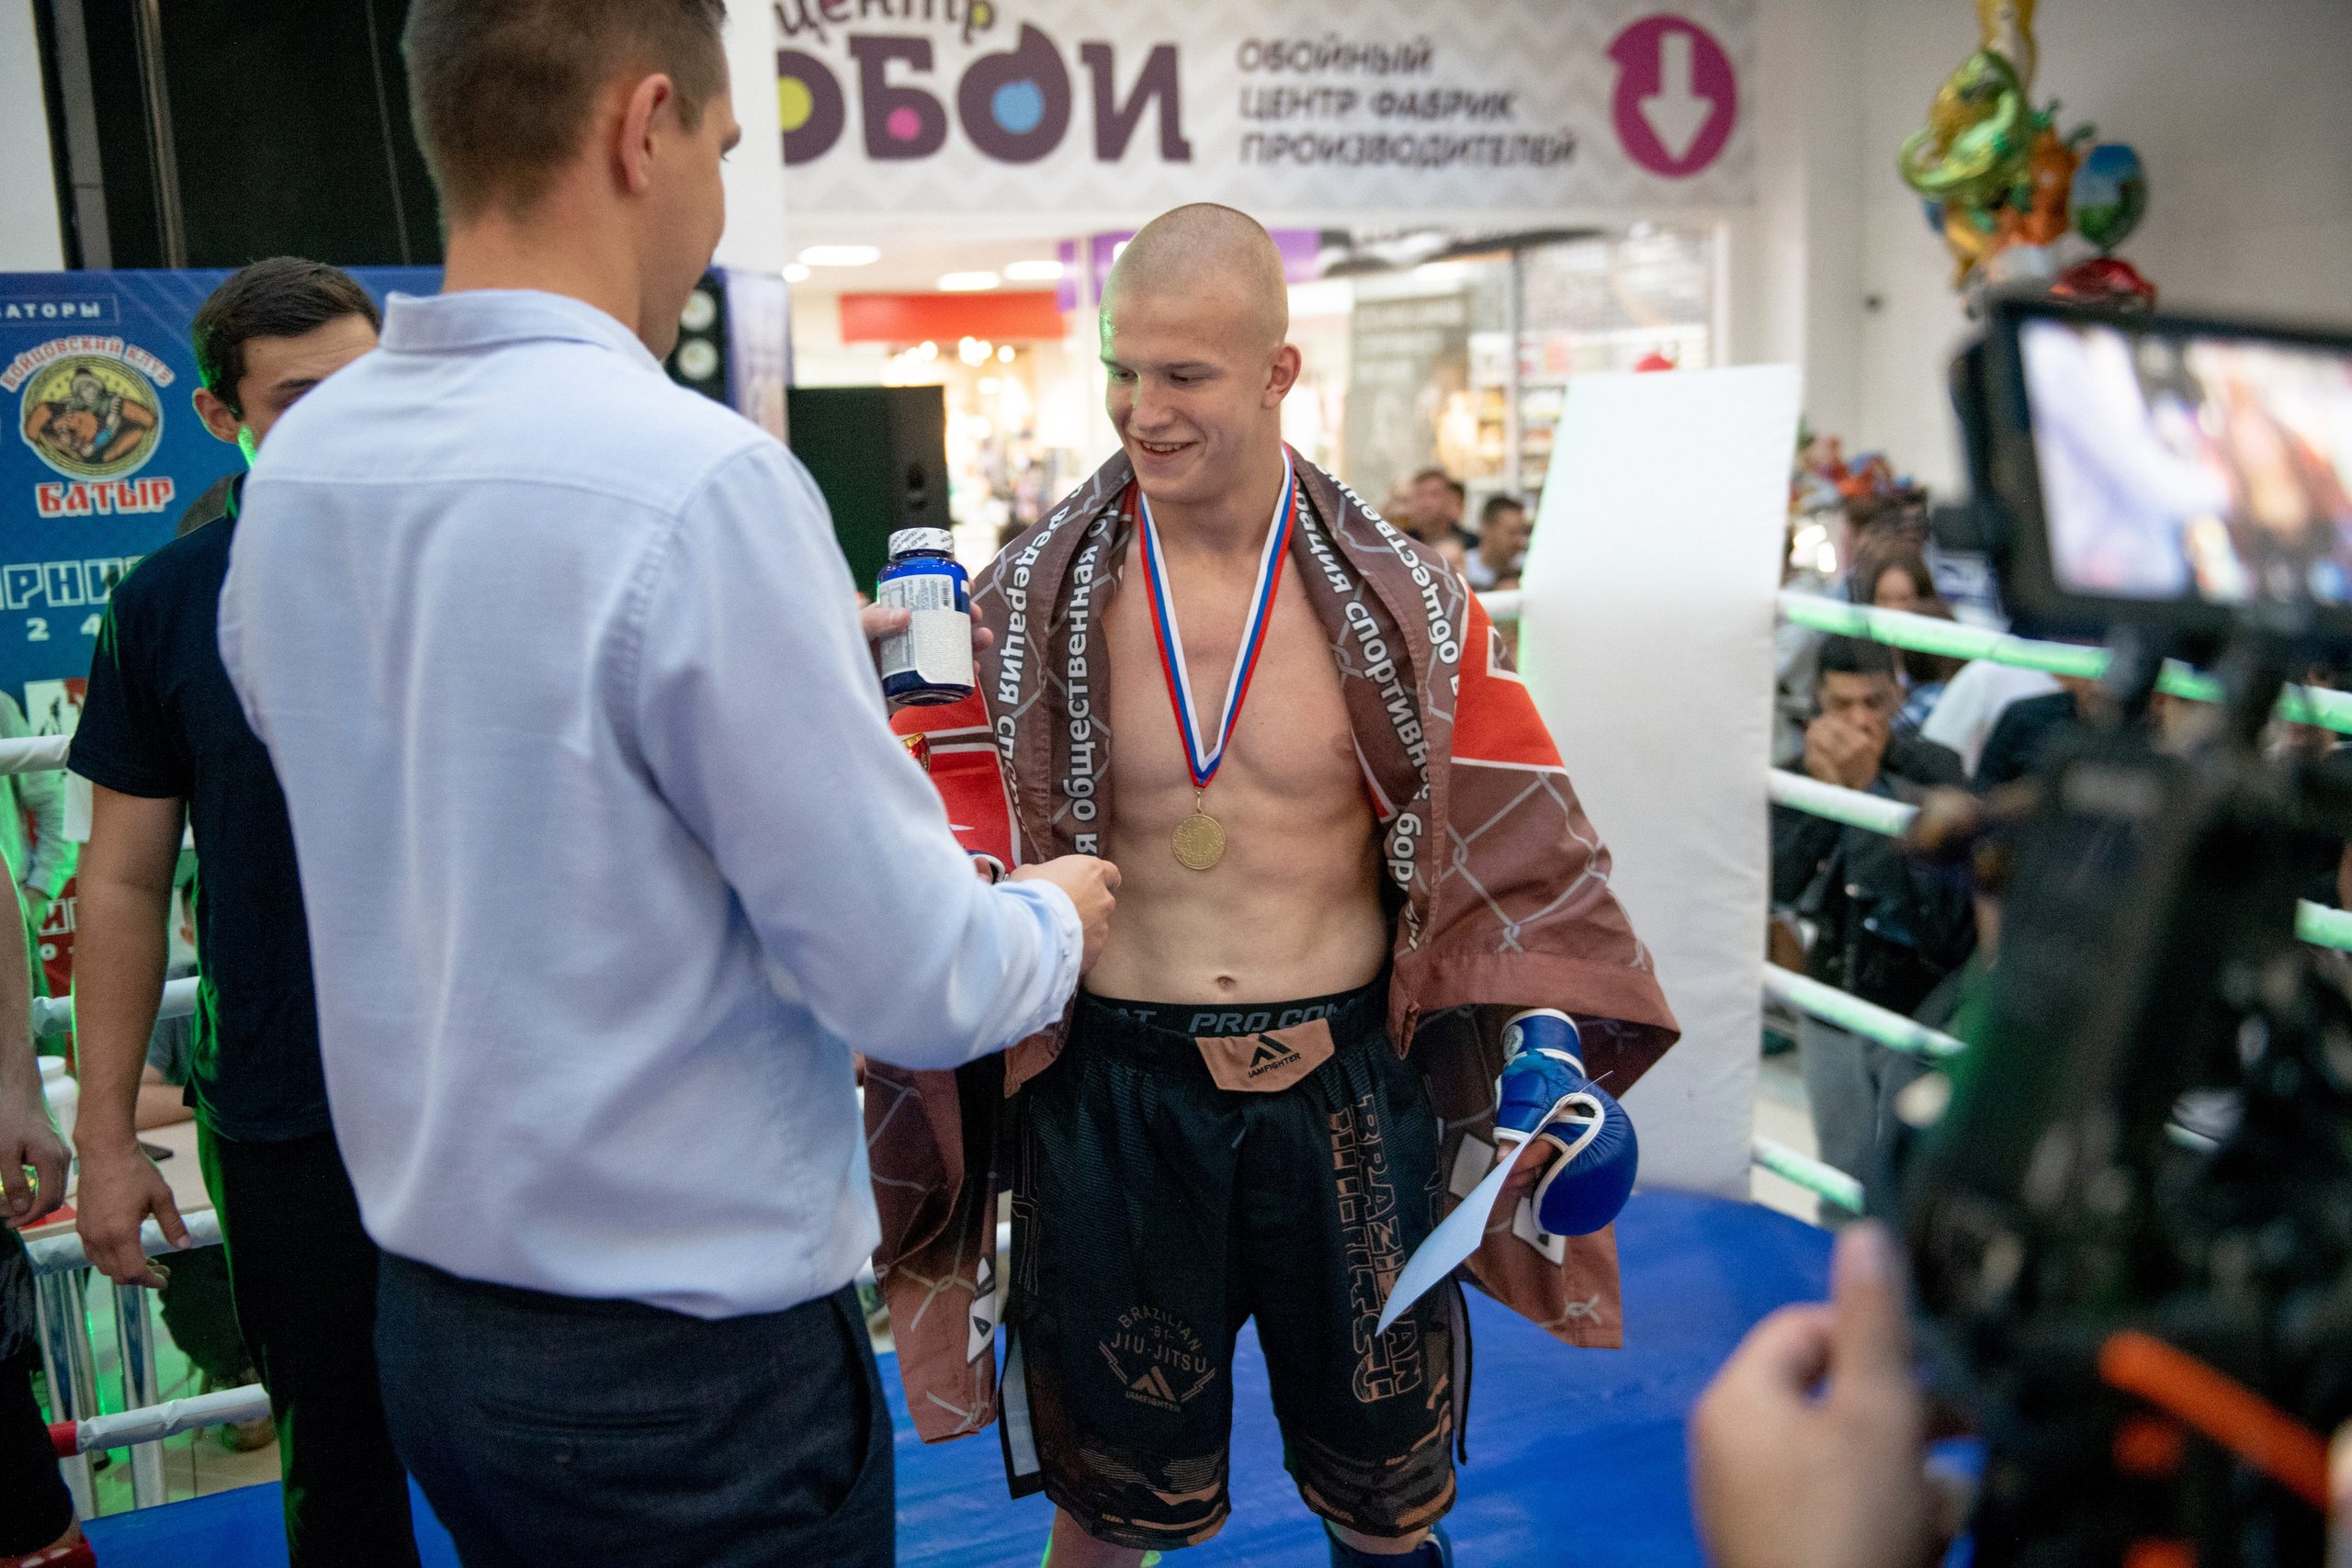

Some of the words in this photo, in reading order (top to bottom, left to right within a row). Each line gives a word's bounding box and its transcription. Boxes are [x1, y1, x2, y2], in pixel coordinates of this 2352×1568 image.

[1237, 33, 1433, 73] ОБОЙНЫЙ
[1239, 87, 1358, 120] ЦЕНТР
[1369, 87, 1513, 121] ФАБРИК
[1240, 127, 1577, 168] ПРОИЗВОДИТЕЛЕЙ
[0, 302, 100, 319] АТОРЫ
[125, 344, 175, 387] КЛУБ
[37, 478, 175, 517] БАТЫР
[0, 556, 145, 610] РНИ
[1063, 546, 1099, 821] общественная
[1188, 1012, 1272, 1033] PRO
[1249, 1053, 1302, 1078] IAMFIGHTER
[1118, 1305, 1202, 1351] BRAZILIAN
[1110, 1332, 1207, 1373] JIU-JITSU
[1125, 1391, 1182, 1413] IAMFIGHTER
